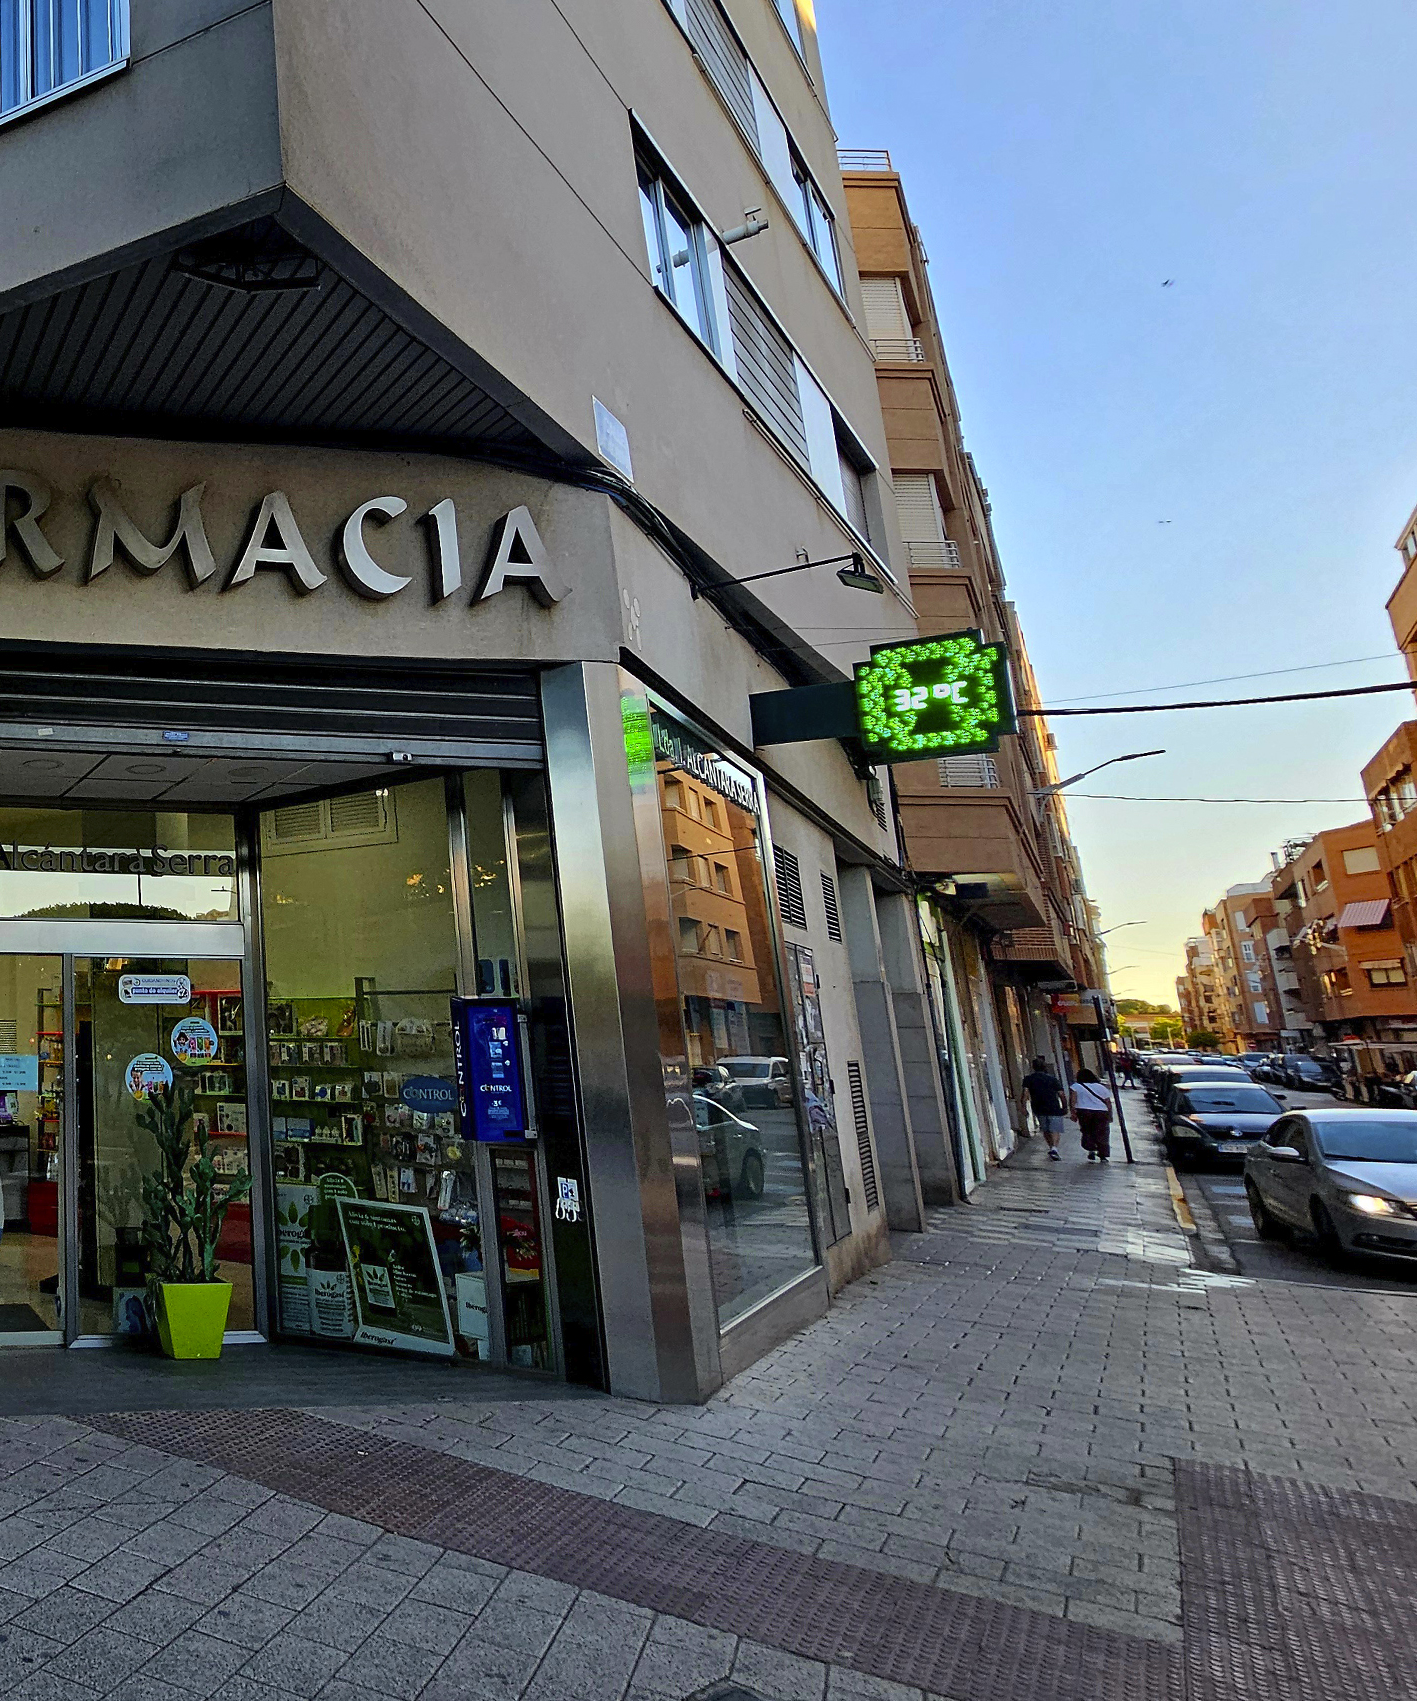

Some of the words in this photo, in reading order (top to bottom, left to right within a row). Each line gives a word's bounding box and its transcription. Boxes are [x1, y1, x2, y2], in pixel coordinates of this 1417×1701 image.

[893, 685, 929, 712] 32
[149, 844, 237, 879] Serra
[403, 1085, 455, 1101] CONTROL
[360, 1331, 397, 1346] Iberogast
